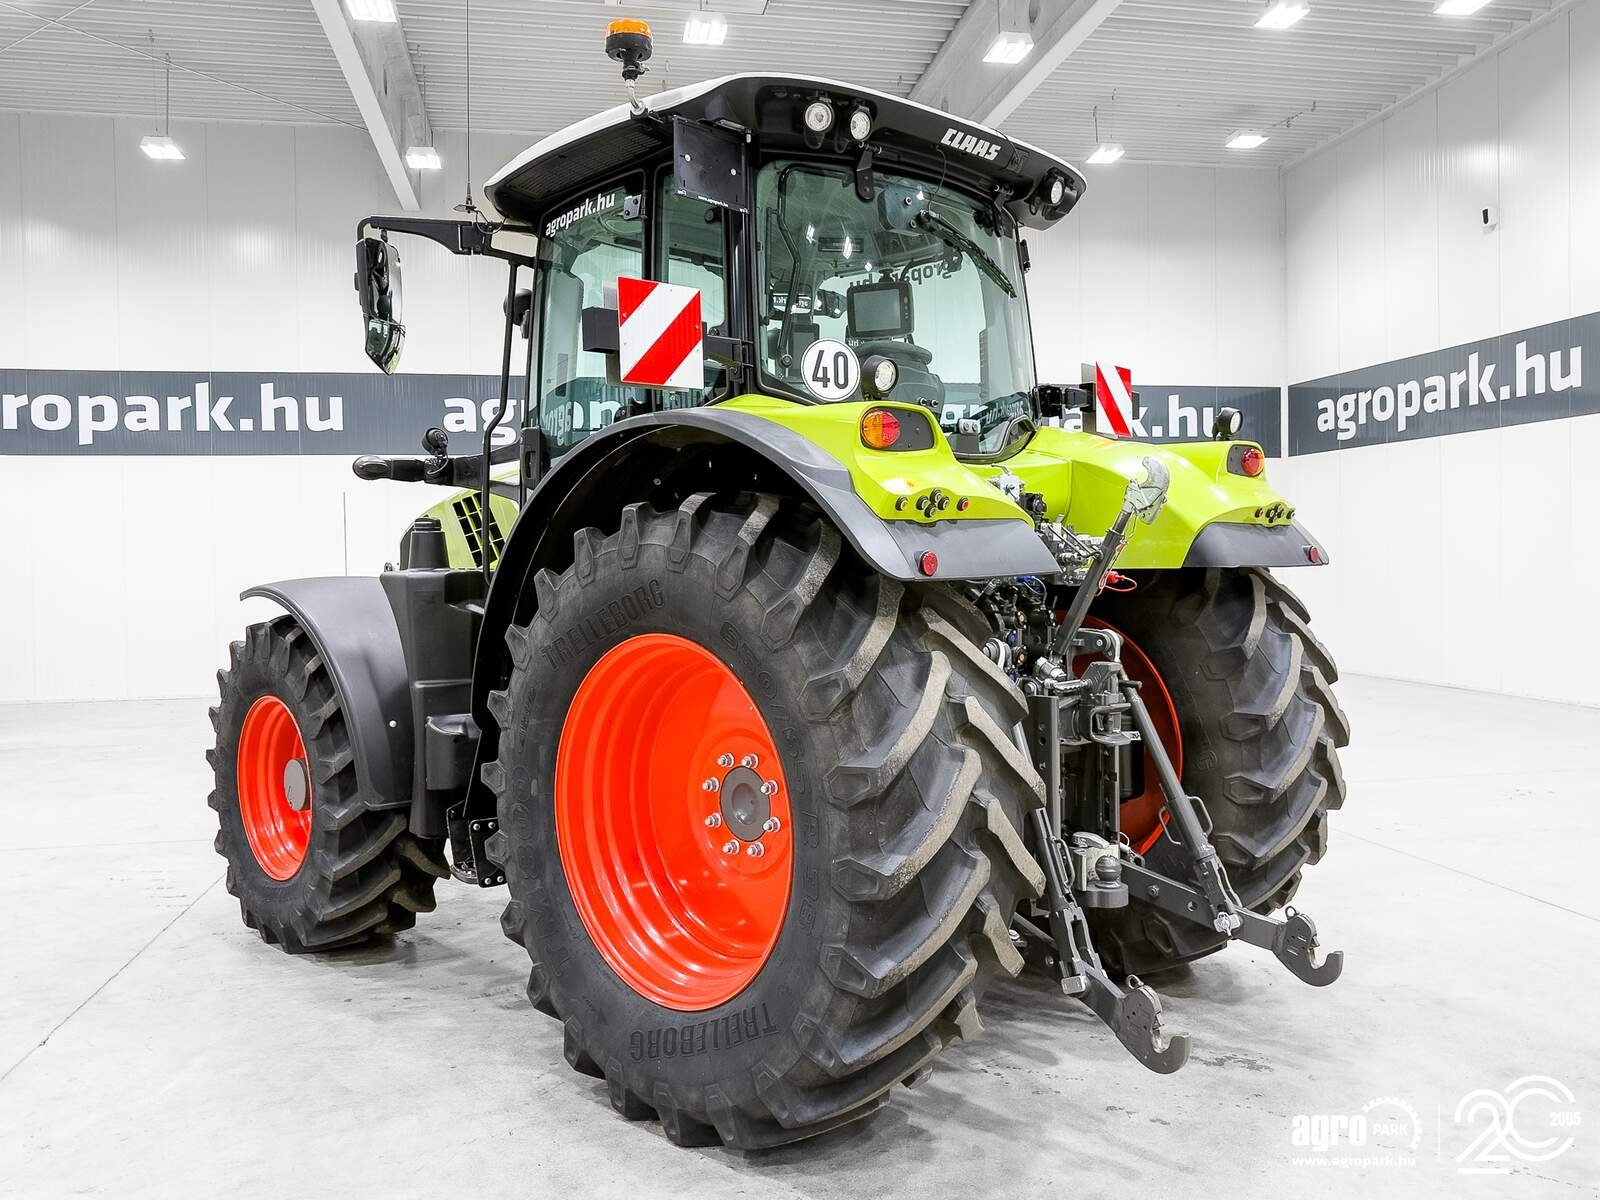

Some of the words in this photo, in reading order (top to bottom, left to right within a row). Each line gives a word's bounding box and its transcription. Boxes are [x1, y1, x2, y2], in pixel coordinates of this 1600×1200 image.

[940, 128, 1002, 161] CLAAS
[545, 193, 616, 238] agropark.hu
[812, 350, 849, 390] 40
[1316, 340, 1583, 441] agropark.hu
[542, 578, 666, 672] TRELLEBORG
[629, 1002, 780, 1064] TRELLEBORG
